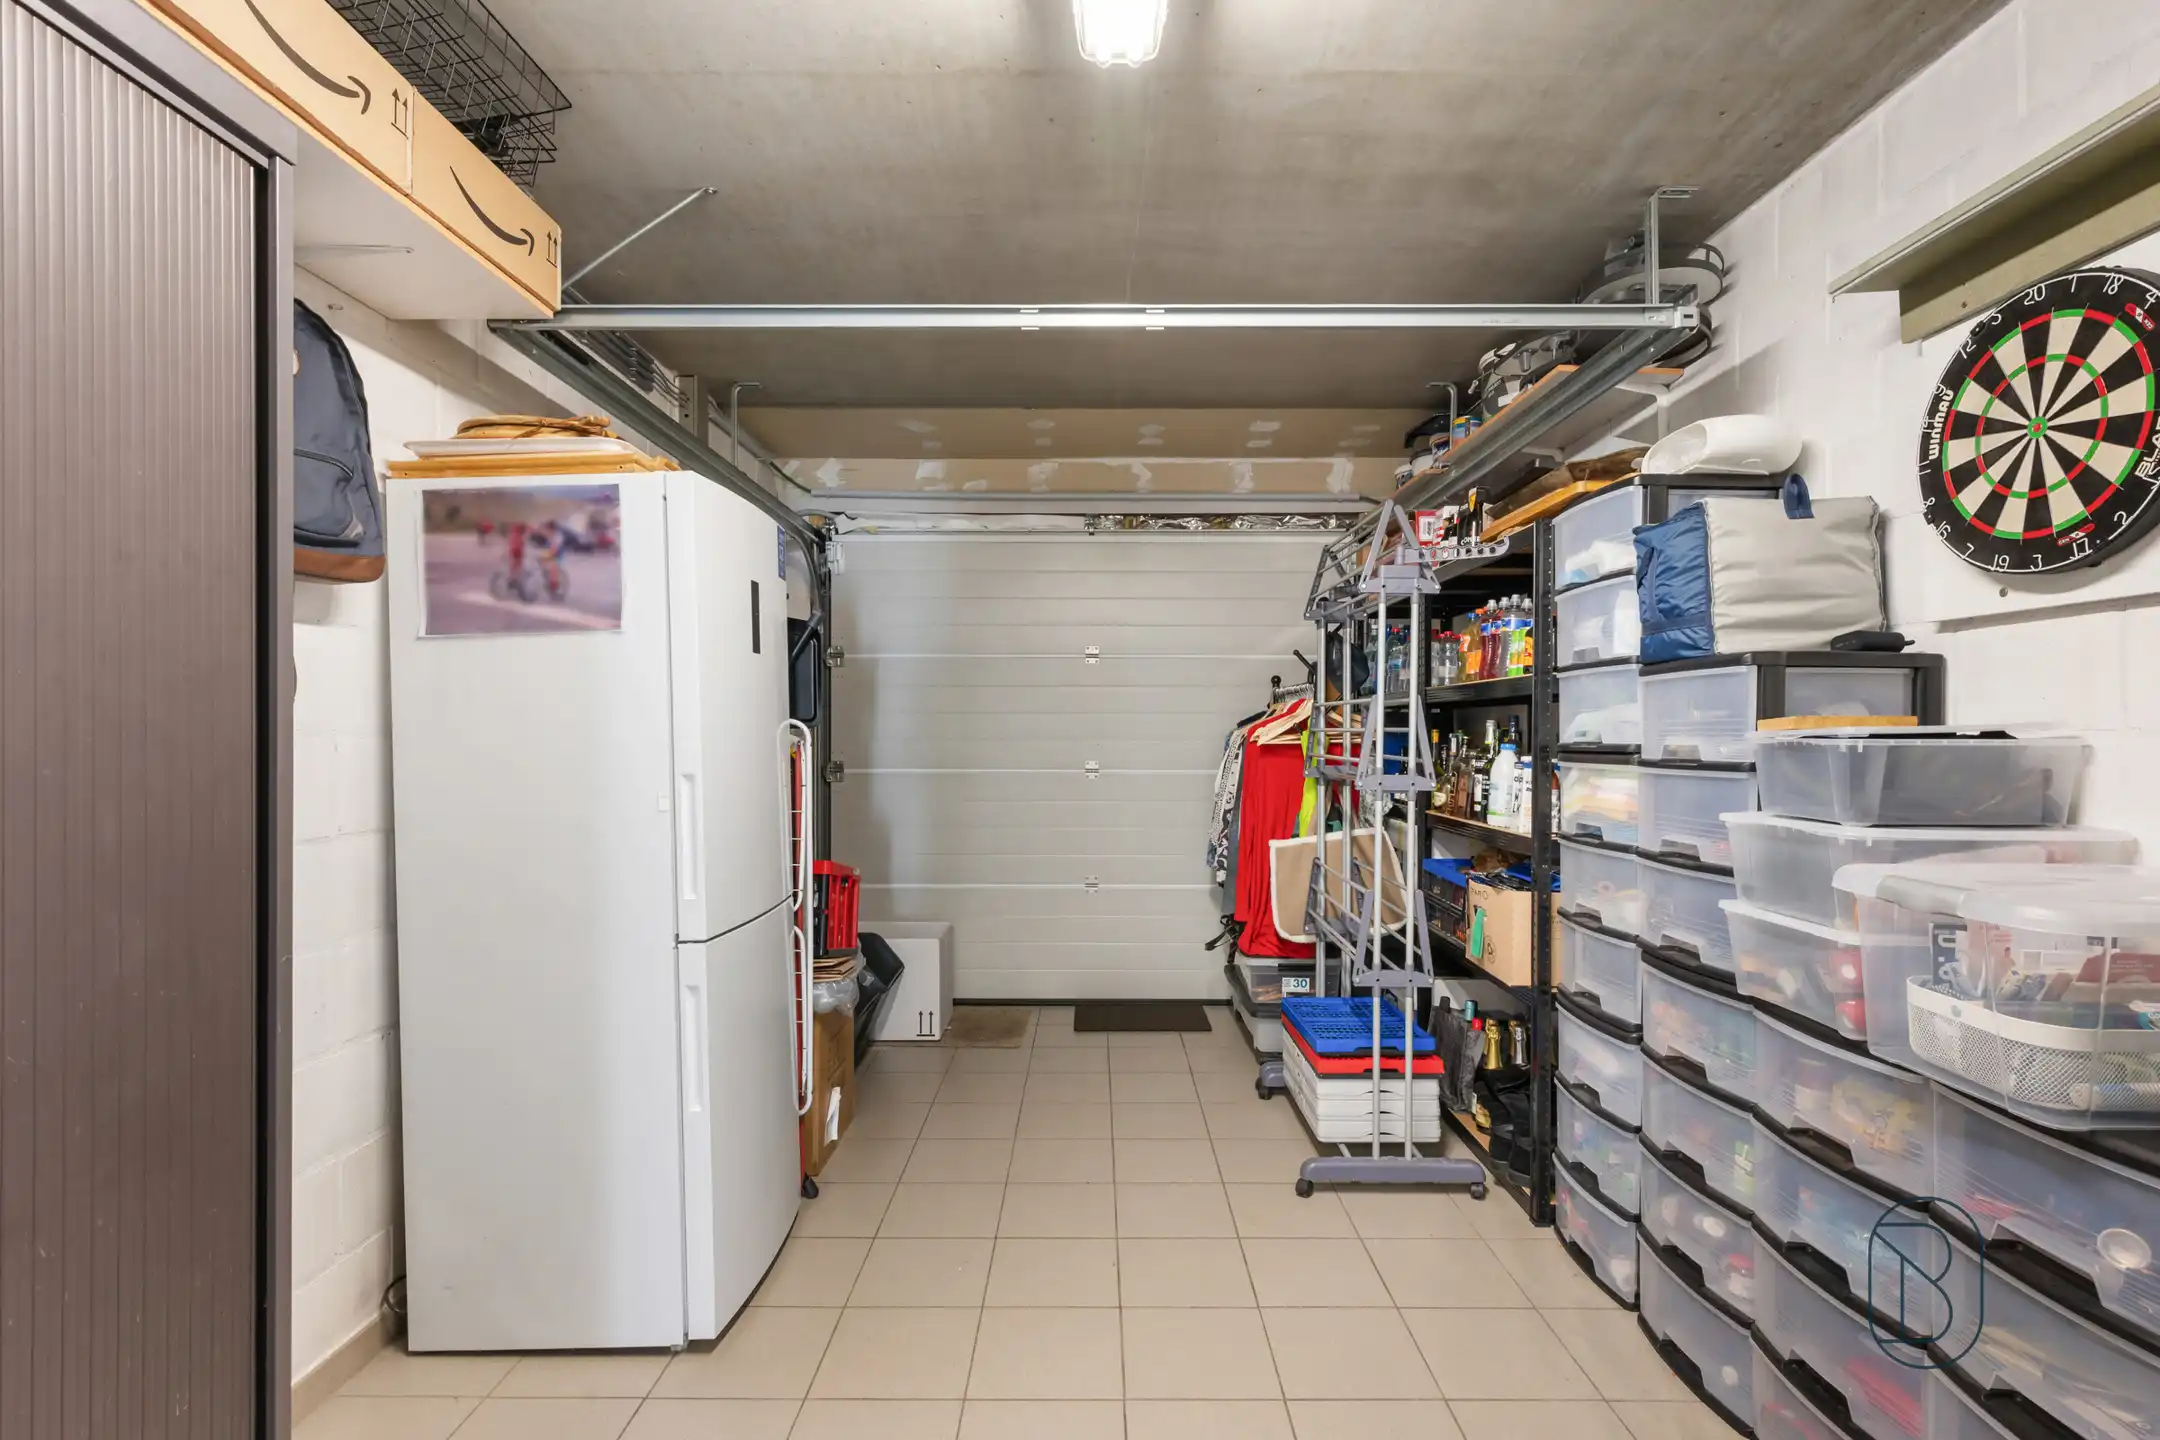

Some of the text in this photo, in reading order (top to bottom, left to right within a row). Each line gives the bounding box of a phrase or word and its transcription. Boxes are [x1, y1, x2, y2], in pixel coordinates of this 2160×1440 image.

[2068, 273, 2077, 293] 1
[2103, 272, 2124, 295] 18
[2023, 283, 2046, 306] 20
[2144, 290, 2159, 310] 4
[1957, 338, 1977, 360] 12
[2113, 510, 2132, 527] 2
[1936, 520, 1952, 541] 16
[1962, 542, 1975, 560] 7
[2069, 537, 2093, 561] 17
[1989, 554, 2010, 573] 19
[2030, 554, 2042, 572] 3
[1292, 978, 1308, 989] 30
